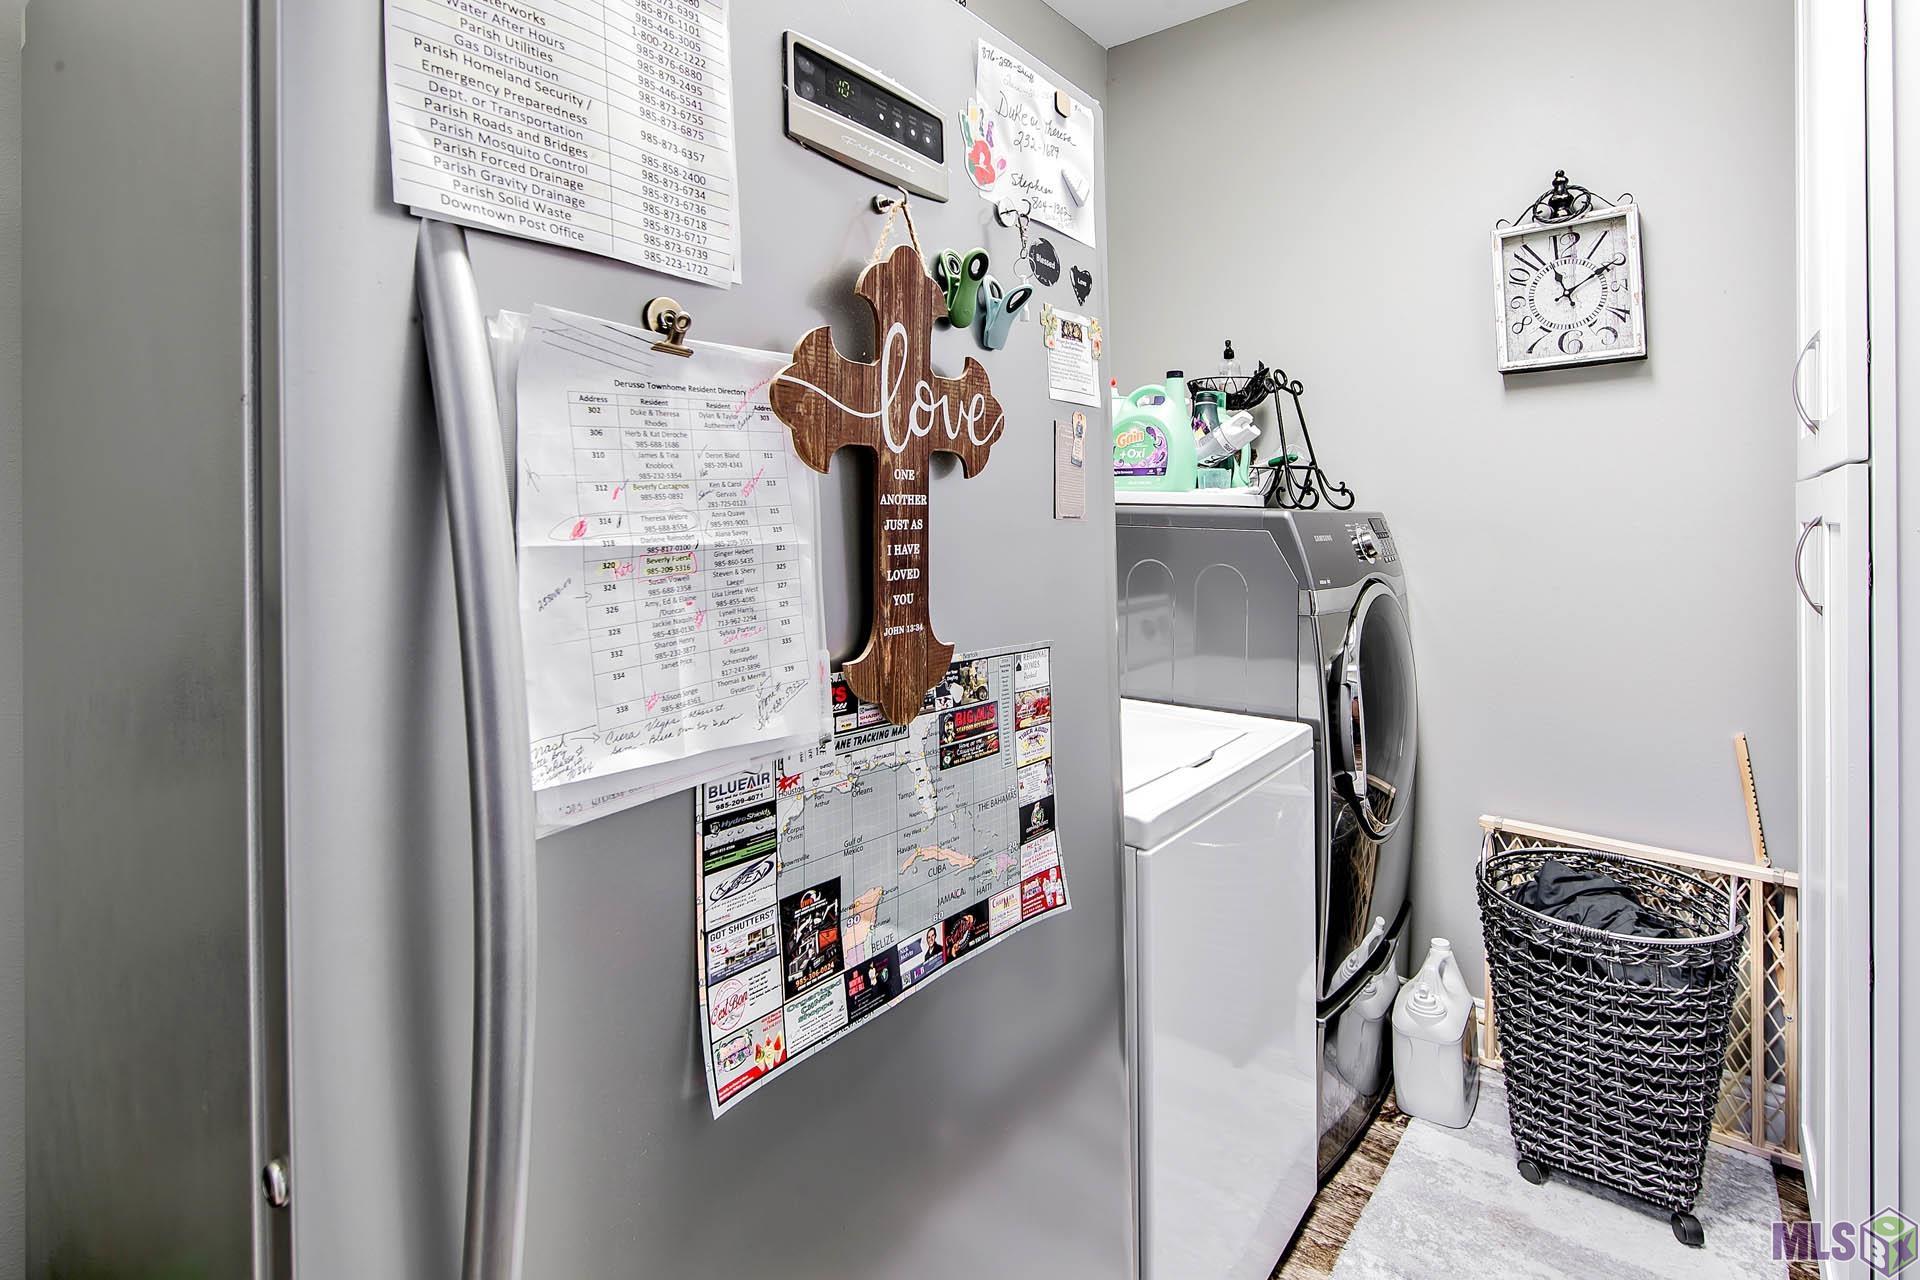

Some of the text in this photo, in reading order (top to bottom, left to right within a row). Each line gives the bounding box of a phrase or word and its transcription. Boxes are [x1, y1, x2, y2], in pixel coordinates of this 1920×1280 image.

[447, 0, 565, 51] Water After Hours
[635, 12, 701, 52] 985-446-3005
[460, 17, 553, 63] Parish Utilities
[632, 26, 706, 68] 1-800-222-1222
[454, 34, 560, 81] Gas Distribution
[636, 43, 703, 81] 985-876-6880
[414, 37, 584, 109] Parish Homeland Security
[637, 59, 703, 96] 985-879-2495
[422, 59, 588, 125] Emergency Preparedness
[637, 75, 703, 111] 985-446-5541
[429, 80, 468, 103] Dept.
[491, 101, 584, 140] Transportation
[638, 90, 704, 126] 985-873-6755
[424, 97, 589, 159] Parish Roads and Bridges
[639, 106, 704, 142] 985-873-6875
[430, 117, 589, 176] Parish Mosquito Control
[640, 130, 705, 163] 985-873-6357
[840, 135, 916, 173] Frigidaire
[434, 137, 585, 191] Parish Forced Drainage
[641, 154, 707, 186] 985-858-2400
[434, 156, 586, 209] Parish Gravity Drainage
[641, 170, 707, 201] 985-873-6734
[1010, 172, 1054, 196] Stephen
[453, 179, 573, 222] Parish Solid Waste
[642, 185, 708, 216] 985-873-6736
[441, 194, 586, 243] Downtown Post Office
[643, 202, 708, 232] 985-873-6718
[643, 218, 708, 247] 985-873-6717
[643, 233, 709, 261] 985-873-6739
[644, 250, 709, 276] 985-223-1722
[1035, 253, 1057, 271] Blessed
[1511, 315, 1532, 335] 8
[1557, 329, 1584, 355] 6
[613, 379, 746, 400] Derusso Townhome Resident Directory
[879, 321, 1004, 453] love
[579, 395, 608, 404] Address
[640, 399, 669, 407] Resident
[704, 402, 731, 410] Resident
[588, 406, 601, 415] 302
[630, 408, 681, 418] Duke Theresa
[760, 414, 770, 422] 303
[590, 429, 603, 437] 306
[1117, 429, 1145, 448] Gain
[592, 451, 606, 460] 310
[893, 468, 915, 482] ONE
[595, 484, 609, 493] 312
[632, 483, 657, 492] Beverly
[766, 480, 777, 488] 313
[879, 493, 928, 506] ANOTHER
[770, 508, 781, 516] 315
[600, 517, 612, 526] 314
[884, 518, 924, 531] JUST AS
[887, 543, 920, 556] I HAVE
[602, 562, 616, 570] 320
[645, 555, 671, 565] Beverly
[645, 564, 692, 576] 985-209-5316
[886, 568, 921, 582] LOVED
[603, 584, 617, 592] 324
[777, 582, 788, 590] 327
[779, 600, 789, 608] 329
[892, 593, 914, 606] YOU
[606, 606, 620, 614] 326
[781, 618, 792, 627] 333
[883, 622, 924, 637] JOHN 13:34
[608, 629, 622, 637] 328
[781, 637, 792, 645] 335
[654, 640, 678, 651] Sharon
[610, 650, 624, 659] 332
[612, 672, 626, 681] 334
[784, 665, 795, 673] 339
[616, 705, 630, 714] 338
[955, 710, 974, 726] BIG
[854, 729, 890, 747] TRACKING
[891, 725, 908, 738] MAP
[708, 772, 771, 800] BLUEAIR
[715, 792, 764, 811] 985-209-4071
[897, 790, 916, 801] Tampa
[977, 790, 1017, 813] THE BAHAMAS
[843, 835, 864, 849] Gulf of
[897, 843, 918, 857] Havana
[843, 845, 864, 858] Mexico
[927, 863, 947, 879] CUBA
[976, 882, 993, 897] HAITI
[846, 914, 862, 928] 90
[932, 911, 945, 922] 80
[710, 930, 726, 943] GOT
[728, 909, 775, 935] SHUTTERS?
[870, 932, 895, 954] BELIZE
